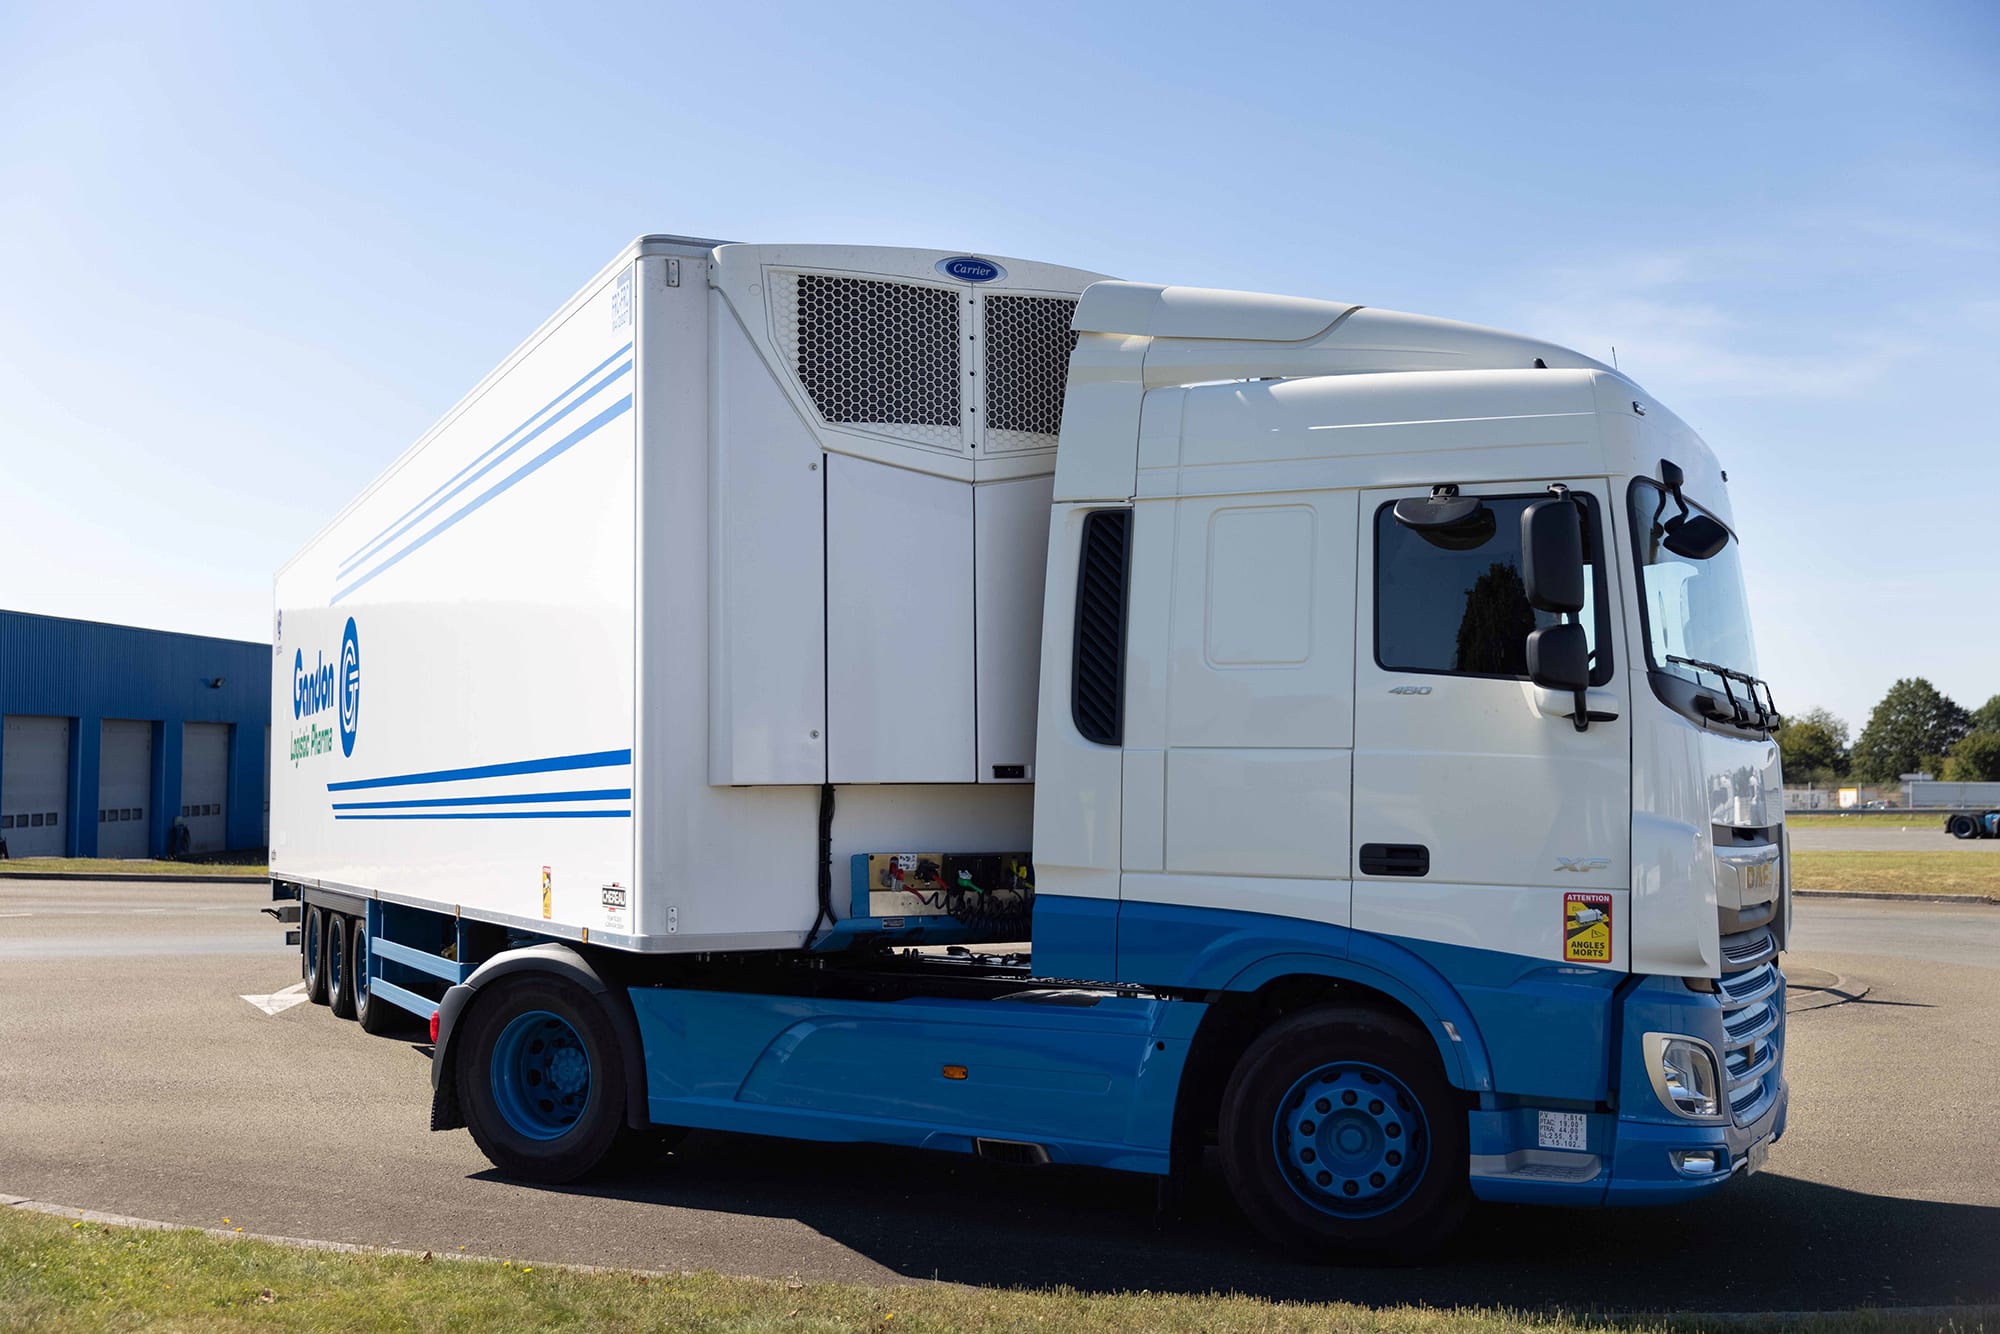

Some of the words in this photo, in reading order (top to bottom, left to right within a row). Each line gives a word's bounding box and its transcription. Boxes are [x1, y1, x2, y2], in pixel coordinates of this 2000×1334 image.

[953, 263, 991, 276] Carrier
[293, 647, 334, 720] Gandon
[1387, 686, 1432, 695] 480
[290, 725, 310, 768] Logistic
[311, 723, 333, 756] Pharma
[1552, 857, 1611, 872] XF
[1745, 864, 1769, 889] DAF
[1567, 894, 1610, 902] ATTENTION
[1571, 941, 1605, 949] ANGLES
[1573, 949, 1604, 957] MORTS
